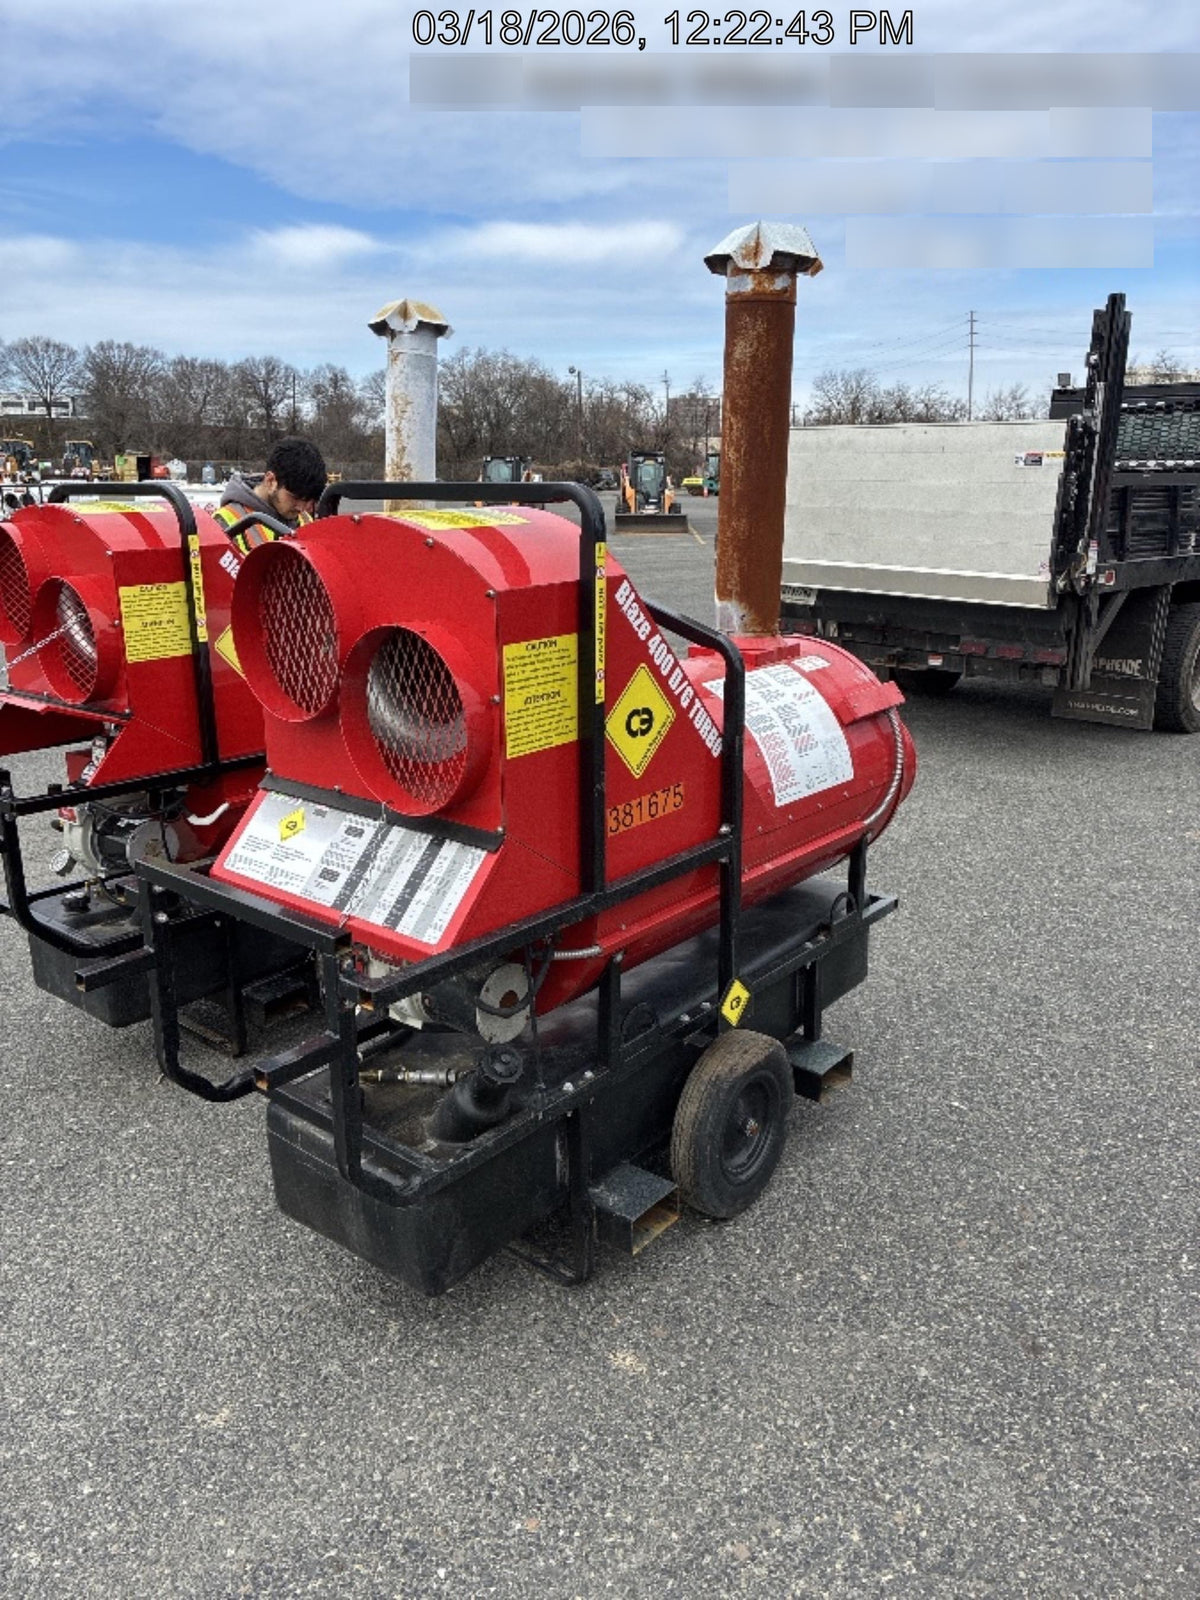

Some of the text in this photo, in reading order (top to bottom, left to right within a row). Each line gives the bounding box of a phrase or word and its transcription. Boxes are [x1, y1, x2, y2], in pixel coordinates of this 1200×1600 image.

[614, 579, 652, 641] Blaze
[647, 633, 675, 677] 400
[687, 697, 723, 759] TURBO
[609, 783, 684, 833] 381675
